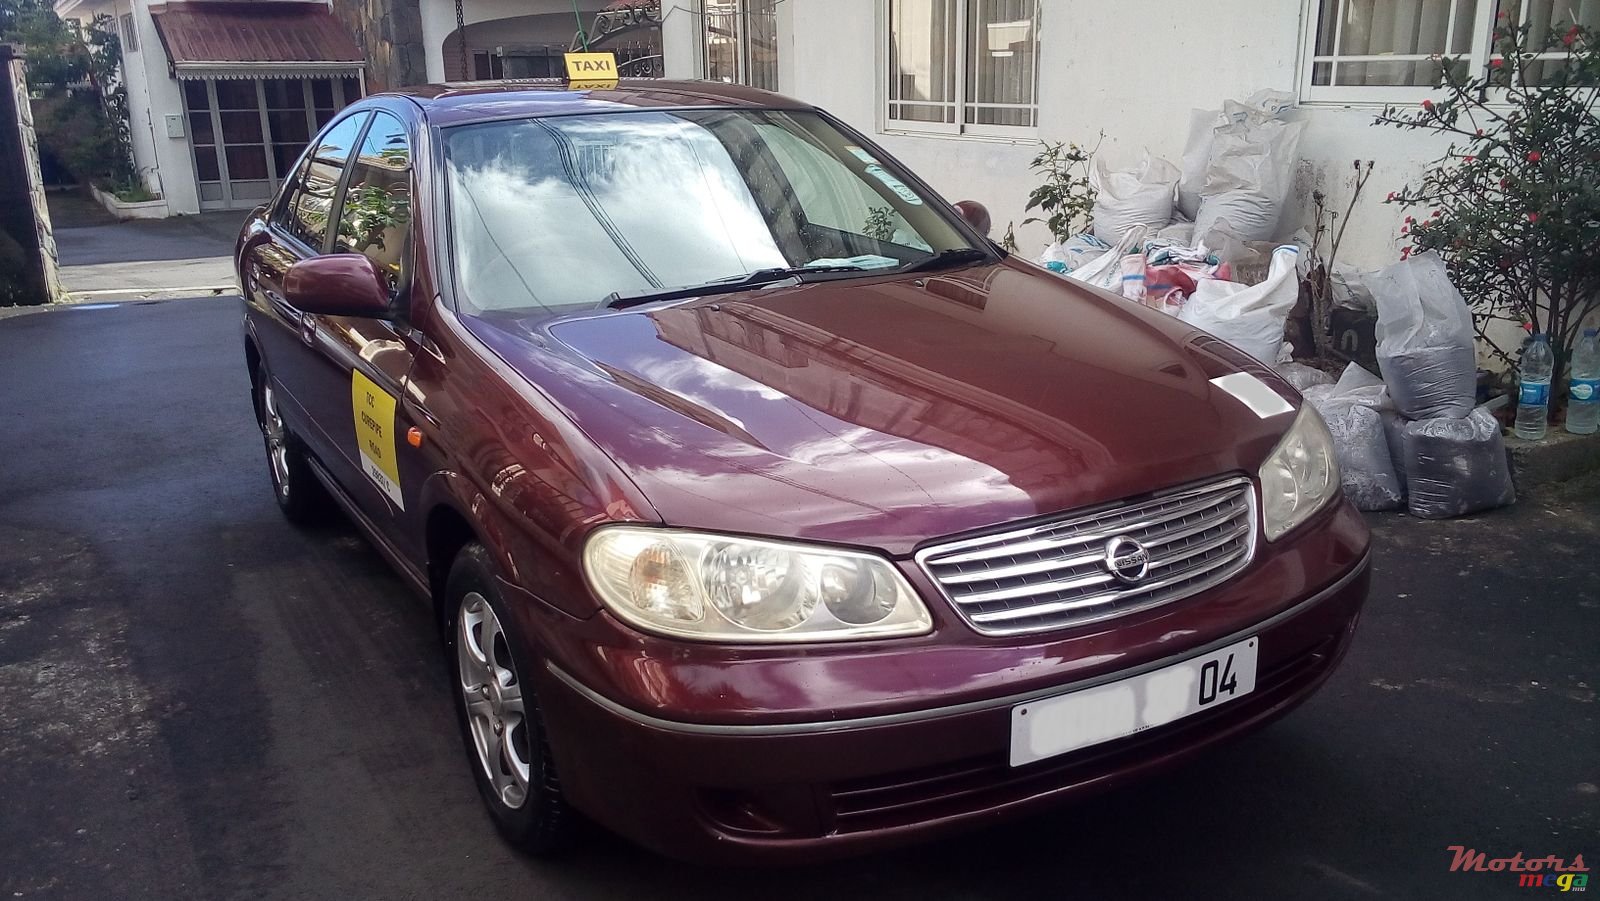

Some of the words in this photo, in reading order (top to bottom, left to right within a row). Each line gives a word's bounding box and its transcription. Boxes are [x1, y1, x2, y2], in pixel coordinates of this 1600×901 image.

[571, 60, 611, 72] TAXI
[1115, 553, 1148, 568] NISSAN
[1199, 653, 1237, 706] 04
